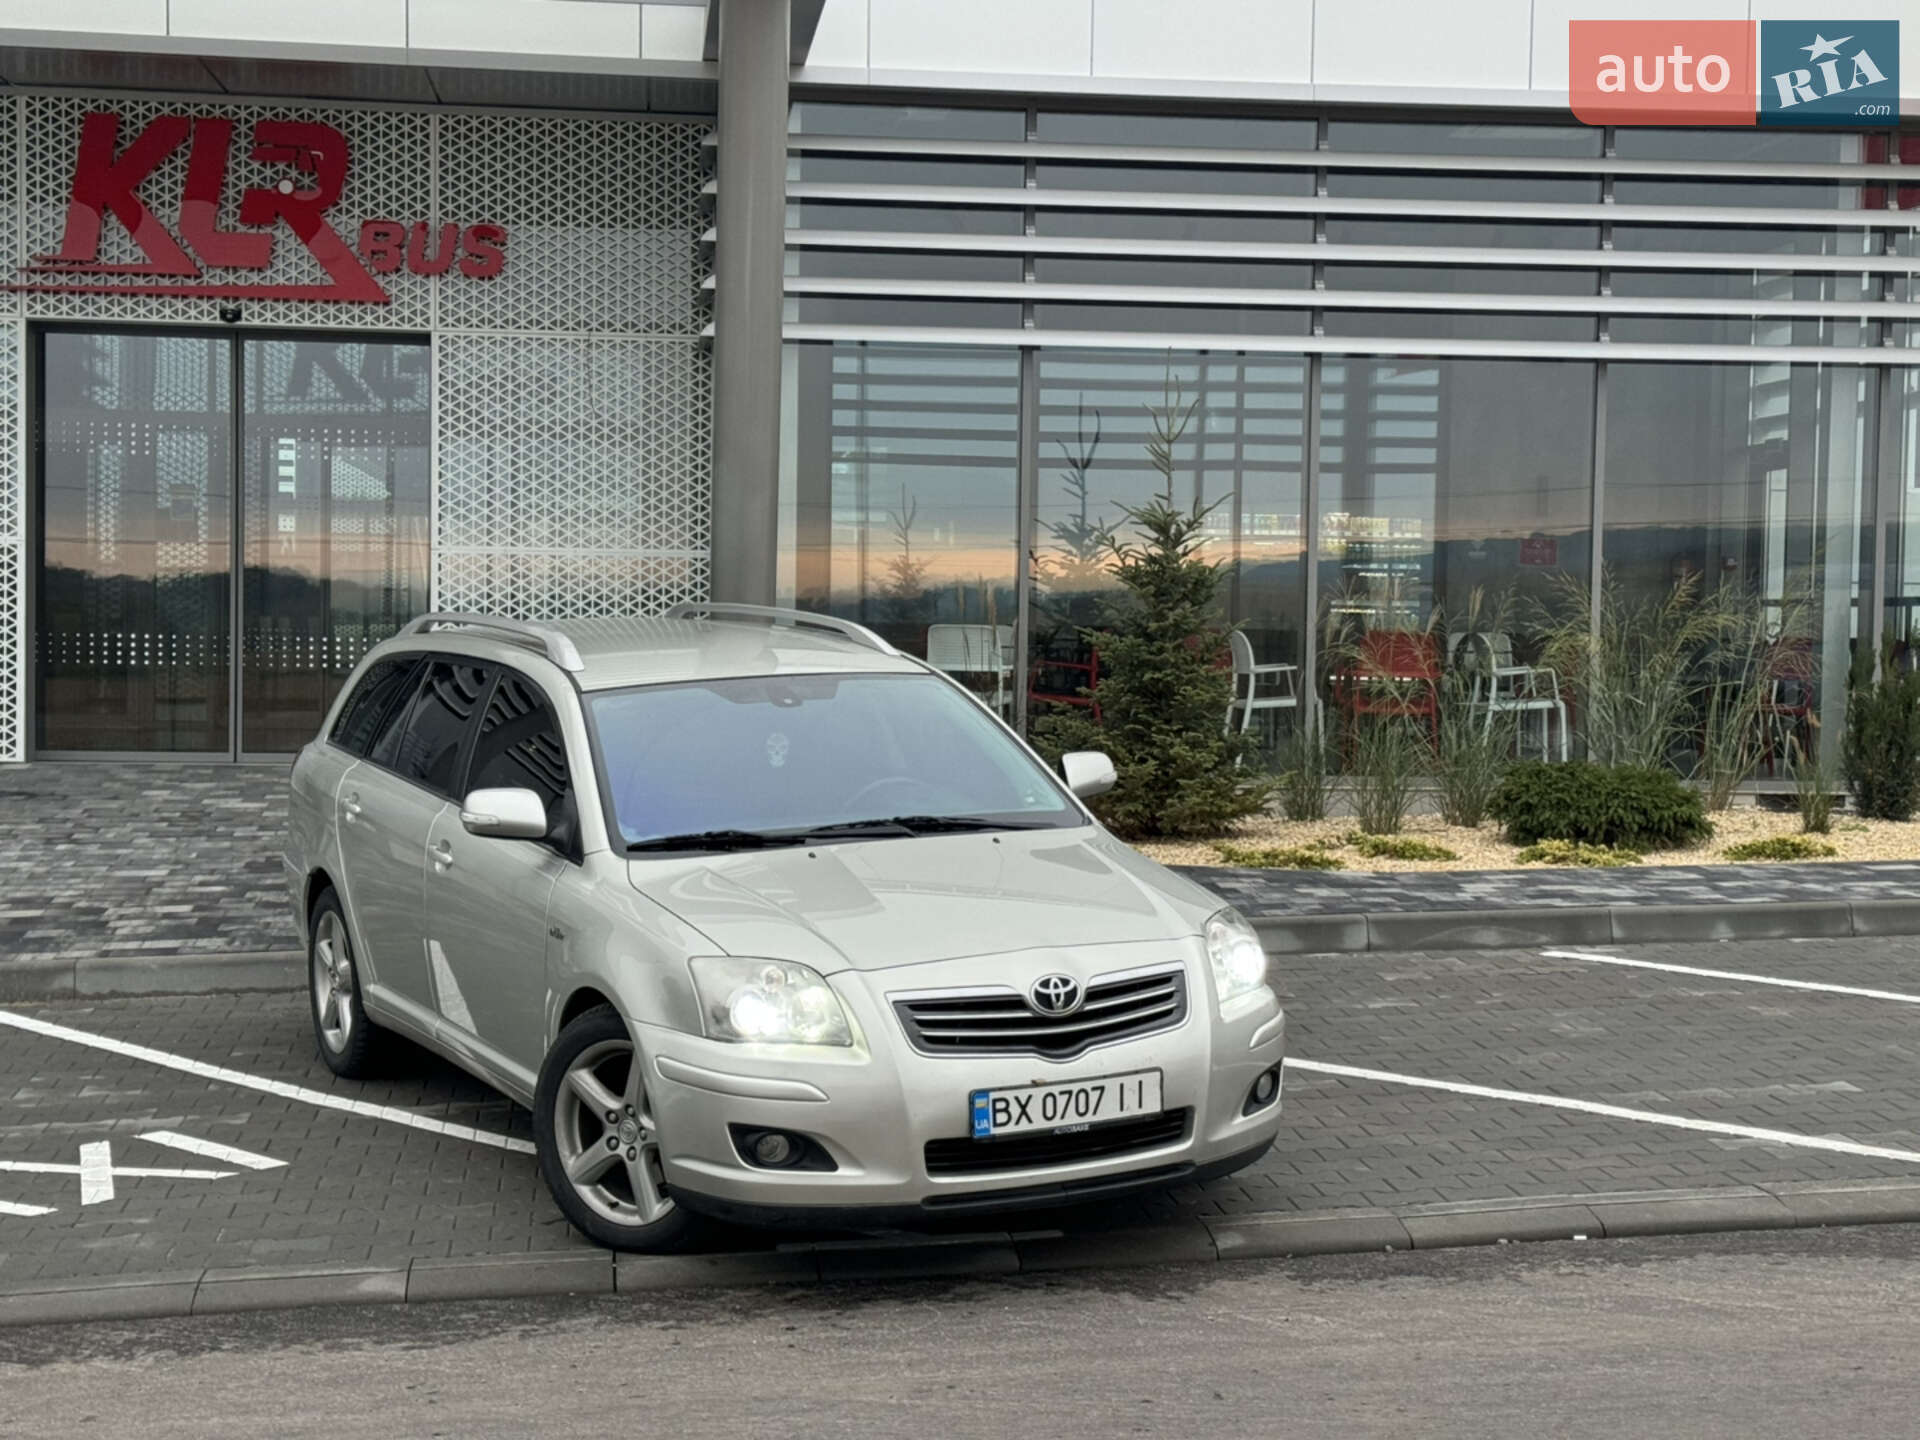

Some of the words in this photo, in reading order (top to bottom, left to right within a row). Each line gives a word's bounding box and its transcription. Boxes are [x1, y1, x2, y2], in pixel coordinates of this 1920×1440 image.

[10, 112, 391, 303] KLR
[358, 220, 507, 278] BUS
[974, 1118, 990, 1129] UA
[991, 1094, 1034, 1128] BX
[1042, 1086, 1105, 1121] 0707
[1119, 1080, 1143, 1112] II
